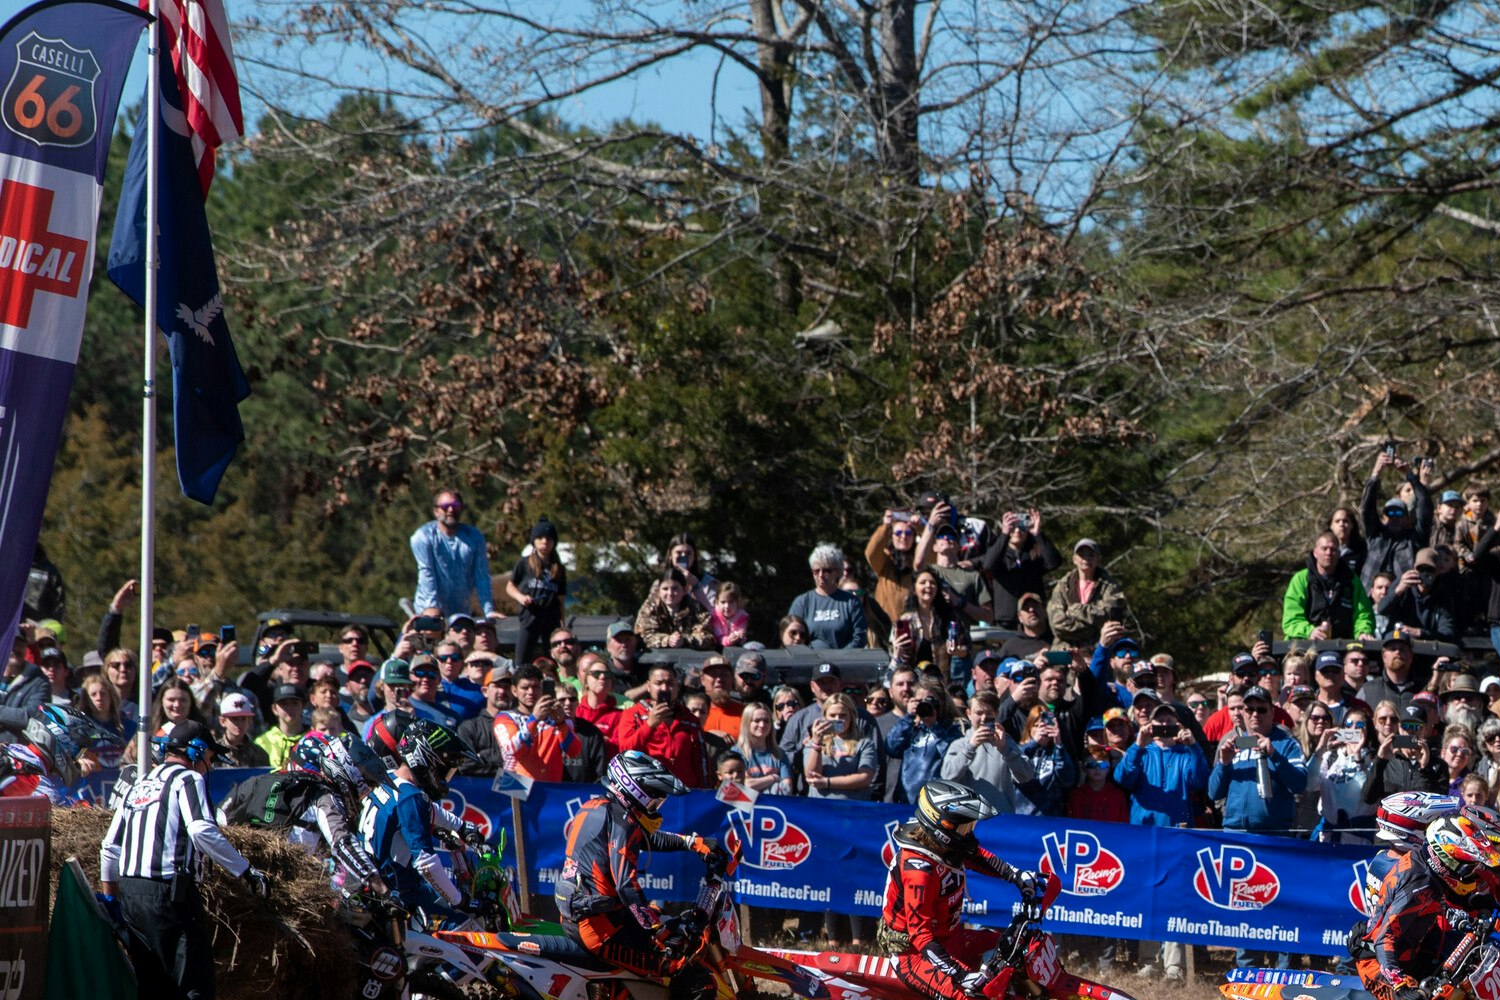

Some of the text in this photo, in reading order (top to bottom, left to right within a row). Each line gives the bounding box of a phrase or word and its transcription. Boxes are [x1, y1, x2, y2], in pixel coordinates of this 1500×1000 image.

[31, 43, 84, 74] CASELLI
[14, 75, 83, 138] 66
[0, 234, 77, 283] DICAL
[727, 805, 787, 868] VP
[764, 842, 810, 861] Racing
[764, 860, 795, 869] FUELS
[1041, 829, 1101, 895] VP
[1079, 867, 1122, 886] Racing
[1196, 844, 1257, 909] VP
[1234, 882, 1278, 900] Racing
[1167, 916, 1300, 943] #MoreThanRaceFuel
[548, 972, 573, 998] 1
